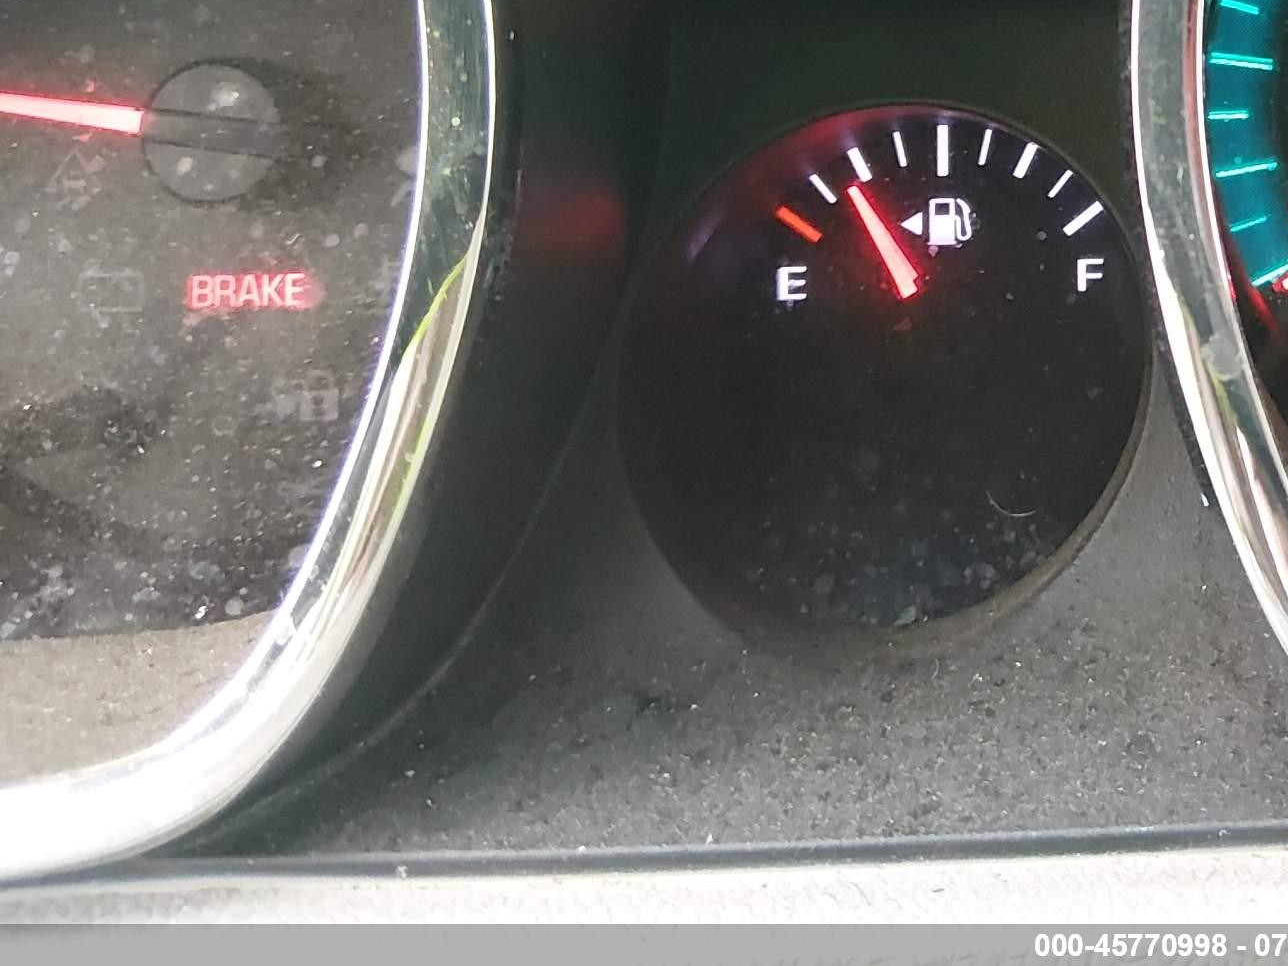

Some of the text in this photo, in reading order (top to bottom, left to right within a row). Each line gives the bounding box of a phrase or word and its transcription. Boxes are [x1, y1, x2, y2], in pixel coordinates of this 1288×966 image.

[190, 274, 306, 308] BRAKE
[776, 265, 808, 301] E
[1076, 257, 1104, 292] F
